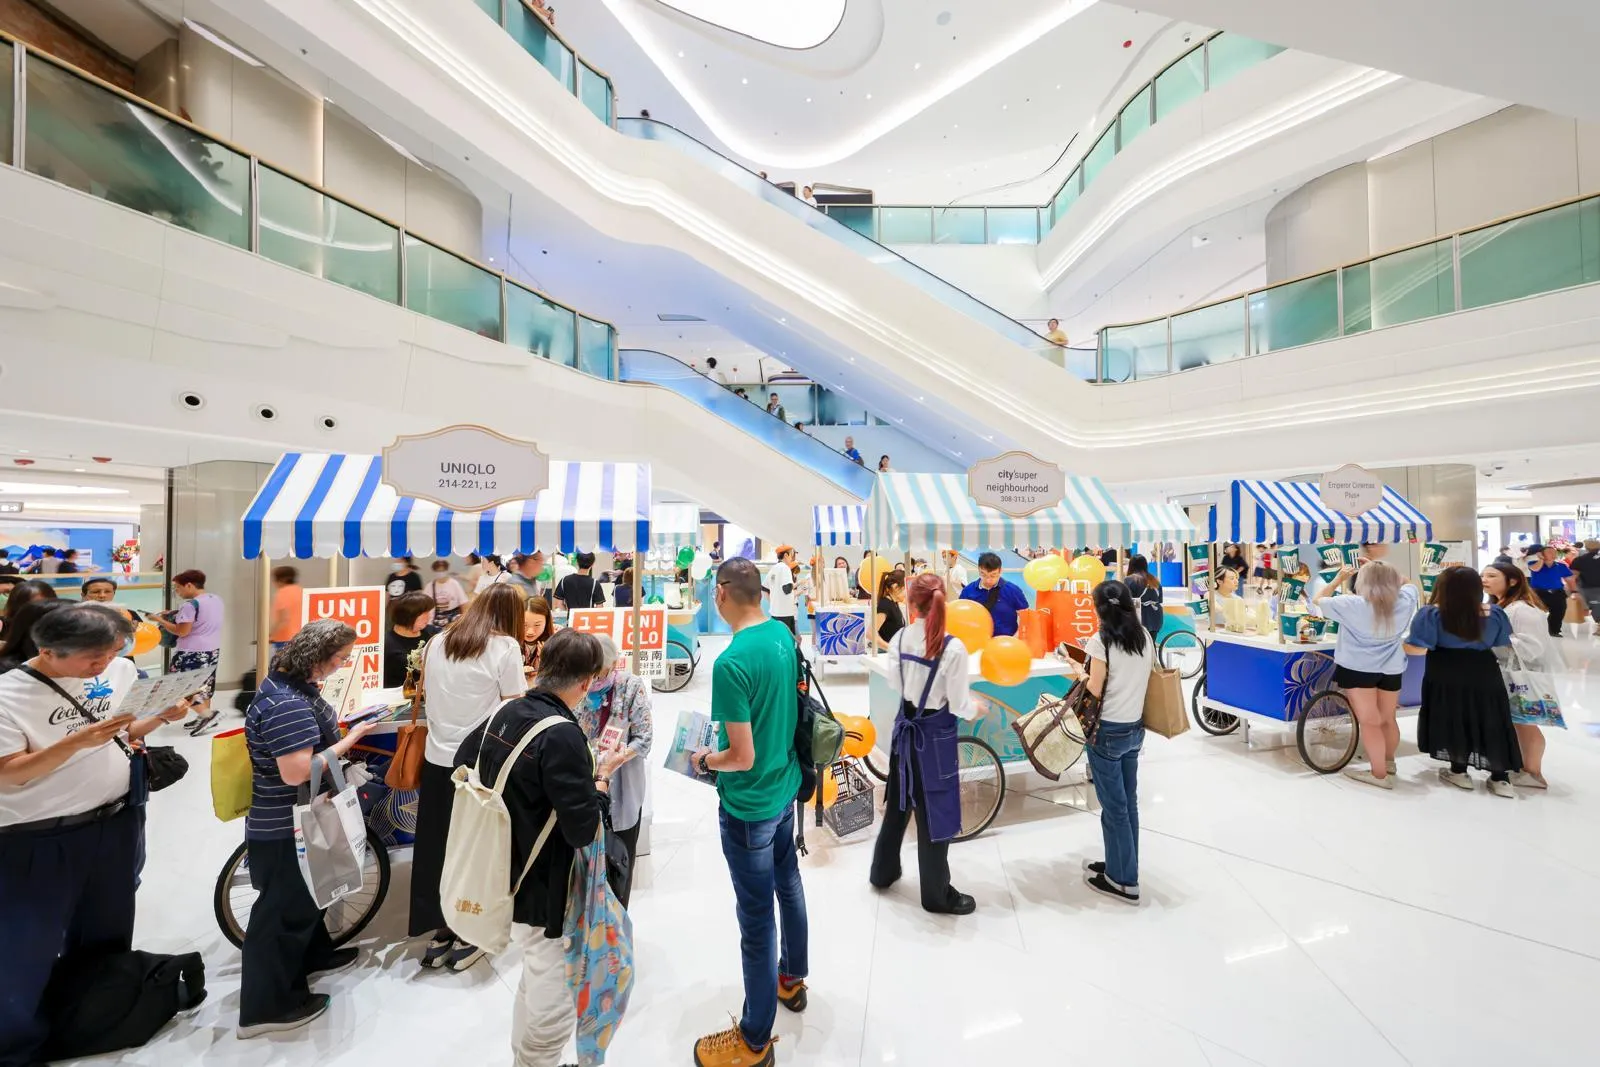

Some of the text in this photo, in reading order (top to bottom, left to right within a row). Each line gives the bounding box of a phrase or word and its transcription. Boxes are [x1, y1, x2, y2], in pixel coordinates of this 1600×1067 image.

[441, 462, 496, 475] UNIQLO
[998, 469, 1038, 480] city'super
[438, 479, 497, 490] 214-221, L2
[986, 483, 1049, 493] neighbourhood
[317, 598, 368, 618] UNI
